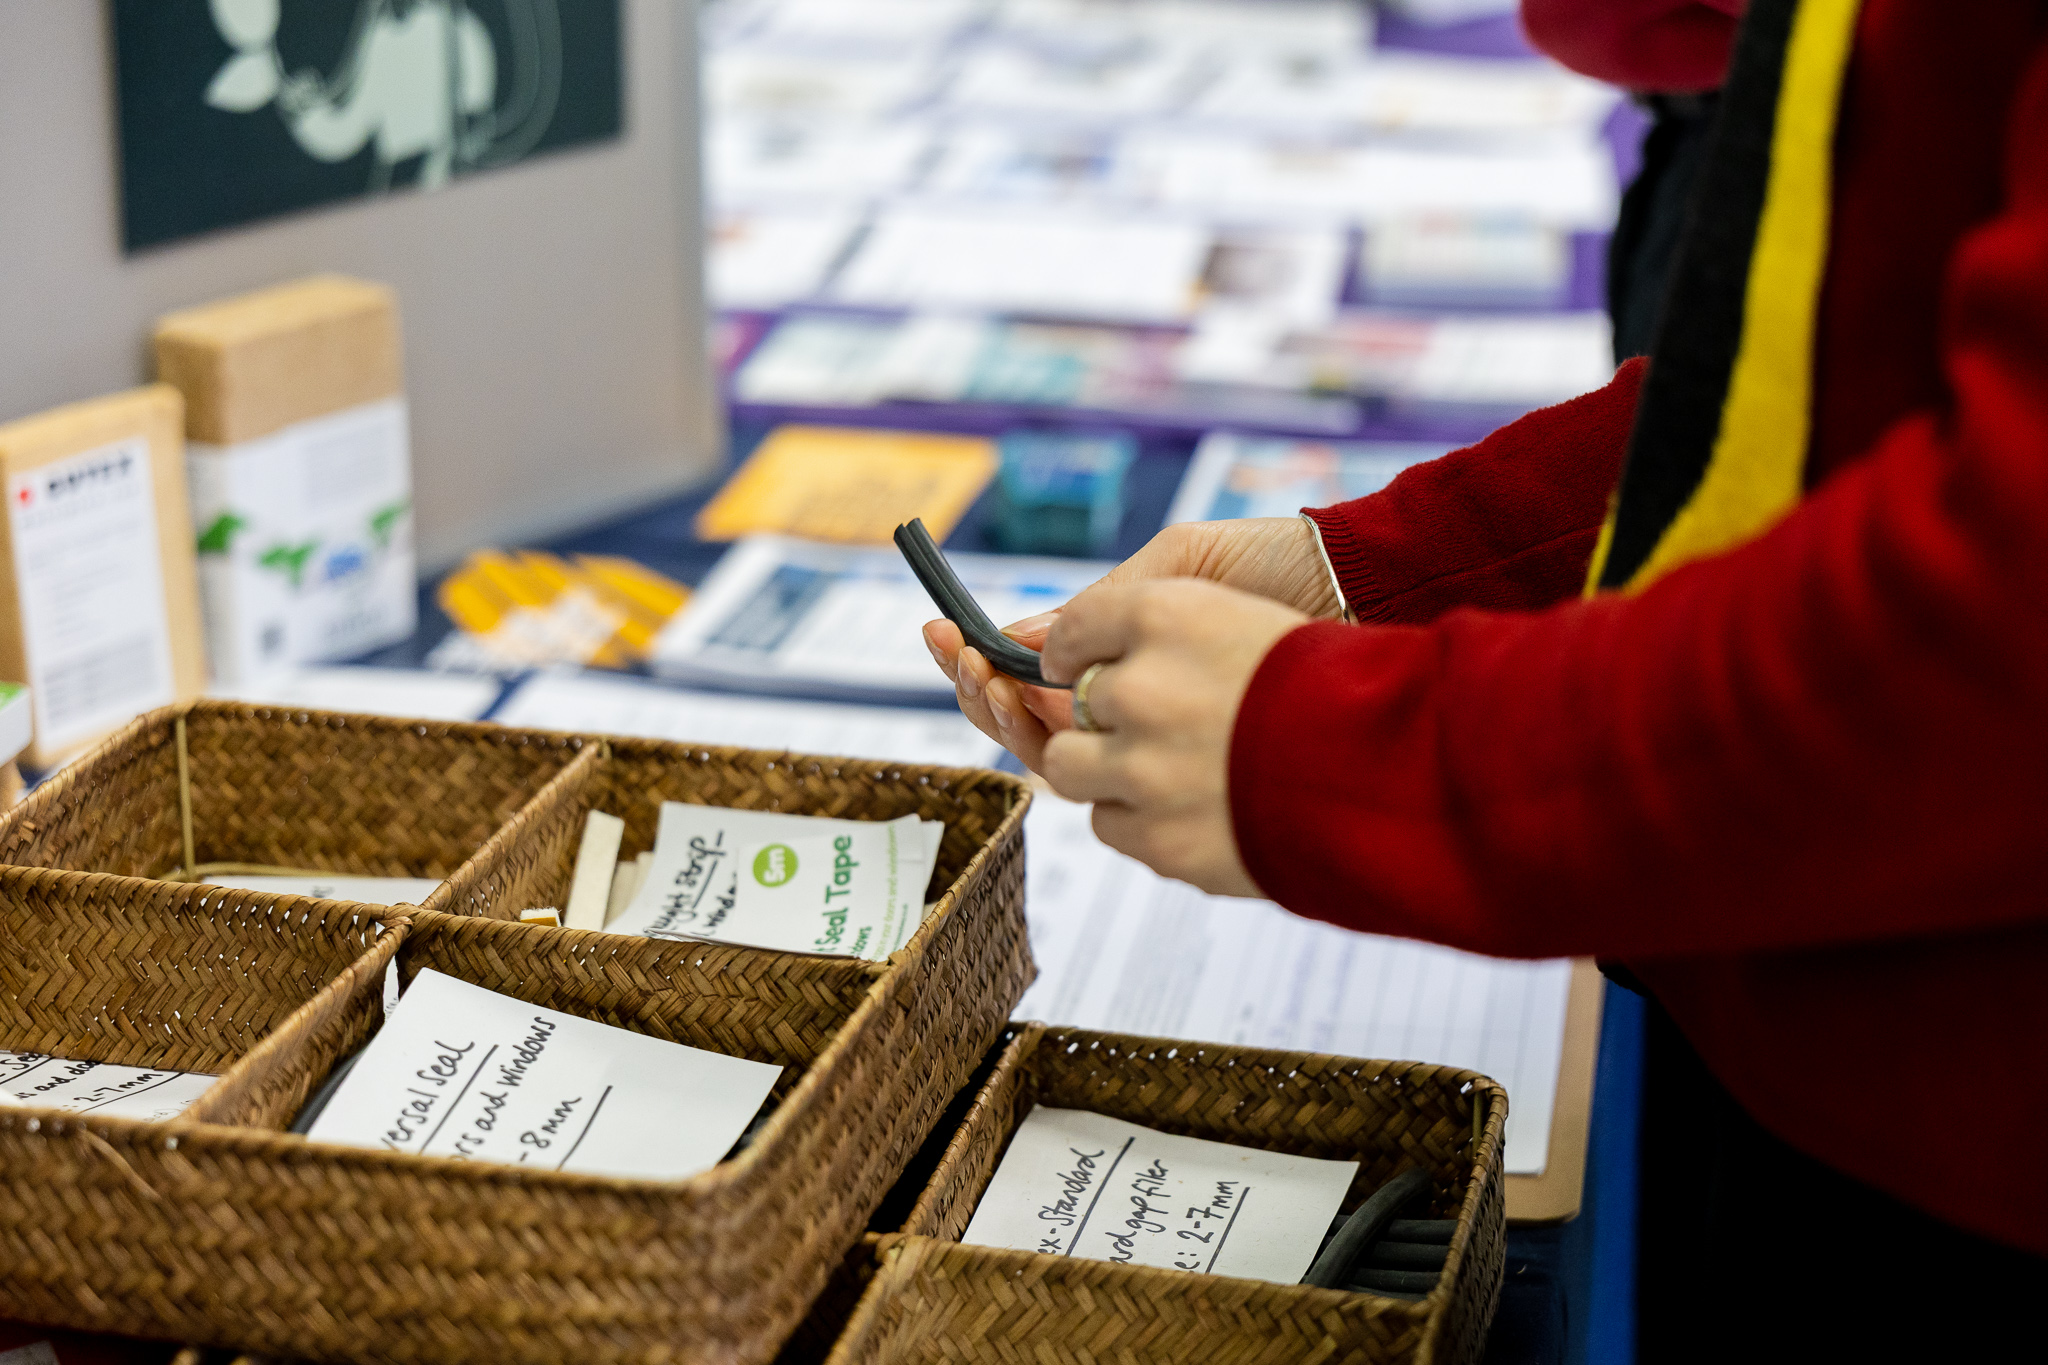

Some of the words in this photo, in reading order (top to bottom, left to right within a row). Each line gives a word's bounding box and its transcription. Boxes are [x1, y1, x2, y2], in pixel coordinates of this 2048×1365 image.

[763, 847, 786, 884] 5m
[825, 835, 860, 904] Tape
[814, 906, 849, 945] Seal
[416, 1039, 475, 1087] Seal
[34, 1075, 77, 1093] and
[474, 1091, 509, 1131] and
[1125, 1196, 1169, 1234] gap
